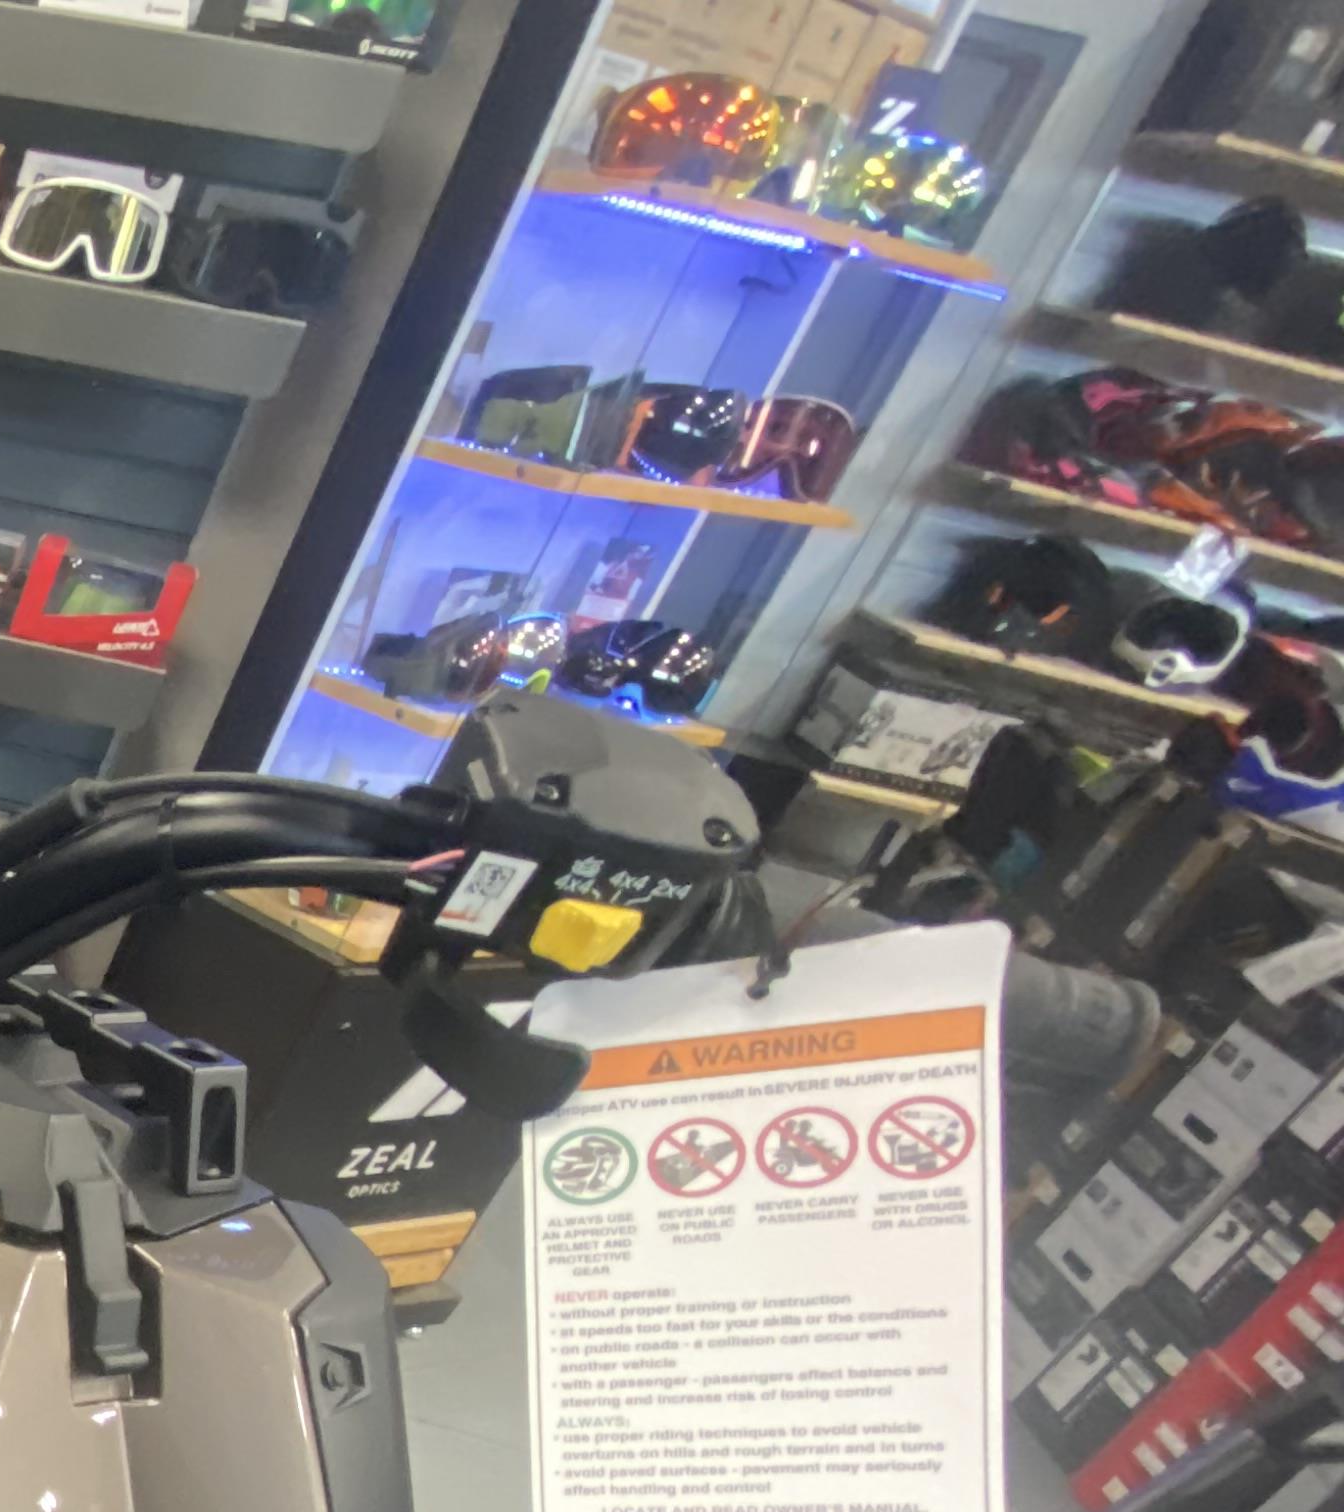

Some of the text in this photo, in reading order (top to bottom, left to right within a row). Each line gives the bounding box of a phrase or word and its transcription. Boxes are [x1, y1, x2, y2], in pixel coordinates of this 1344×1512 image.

[692, 1030, 858, 1069] WARNING
[609, 1097, 640, 1112] ATV
[641, 1098, 669, 1109] use
[670, 1095, 698, 1106] can
[701, 1089, 745, 1104] result
[749, 1086, 763, 1098] in
[764, 1077, 830, 1096] SEVERE
[834, 1071, 895, 1089] INJURY
[899, 1072, 916, 1082] or
[918, 1063, 978, 1081] DEATH
[337, 1140, 437, 1178] ZEAL
[346, 1180, 401, 1199] OPTICS
[878, 1186, 963, 1202] NEVER USE
[755, 1193, 859, 1212] NEVER CARRY
[874, 1200, 968, 1216] WITH DRUGS
[548, 1211, 634, 1228] ALWAYS USE
[657, 1204, 736, 1219] NEVER USE
[758, 1208, 857, 1225] PASSENGERS
[542, 1224, 638, 1241] AN APPROVED
[659, 1217, 734, 1233] ON PUBLIC
[871, 1219, 894, 1231] OR
[547, 1238, 632, 1253] HELMET AND
[673, 1232, 722, 1245] ROADS
[548, 1251, 632, 1265] PROTECTIVE
[572, 1265, 611, 1277] GEAR
[554, 1288, 609, 1304] NEVER
[560, 1295, 852, 1320] without proper training or instruction
[560, 1309, 949, 1338] at speeds too fast for your skills or the conditions
[561, 1385, 893, 1408] steering and increase risk of losing control
[562, 1421, 923, 1445] use proper riding techniques to avoid vehicle
[564, 1481, 772, 1497] affect handling and control
